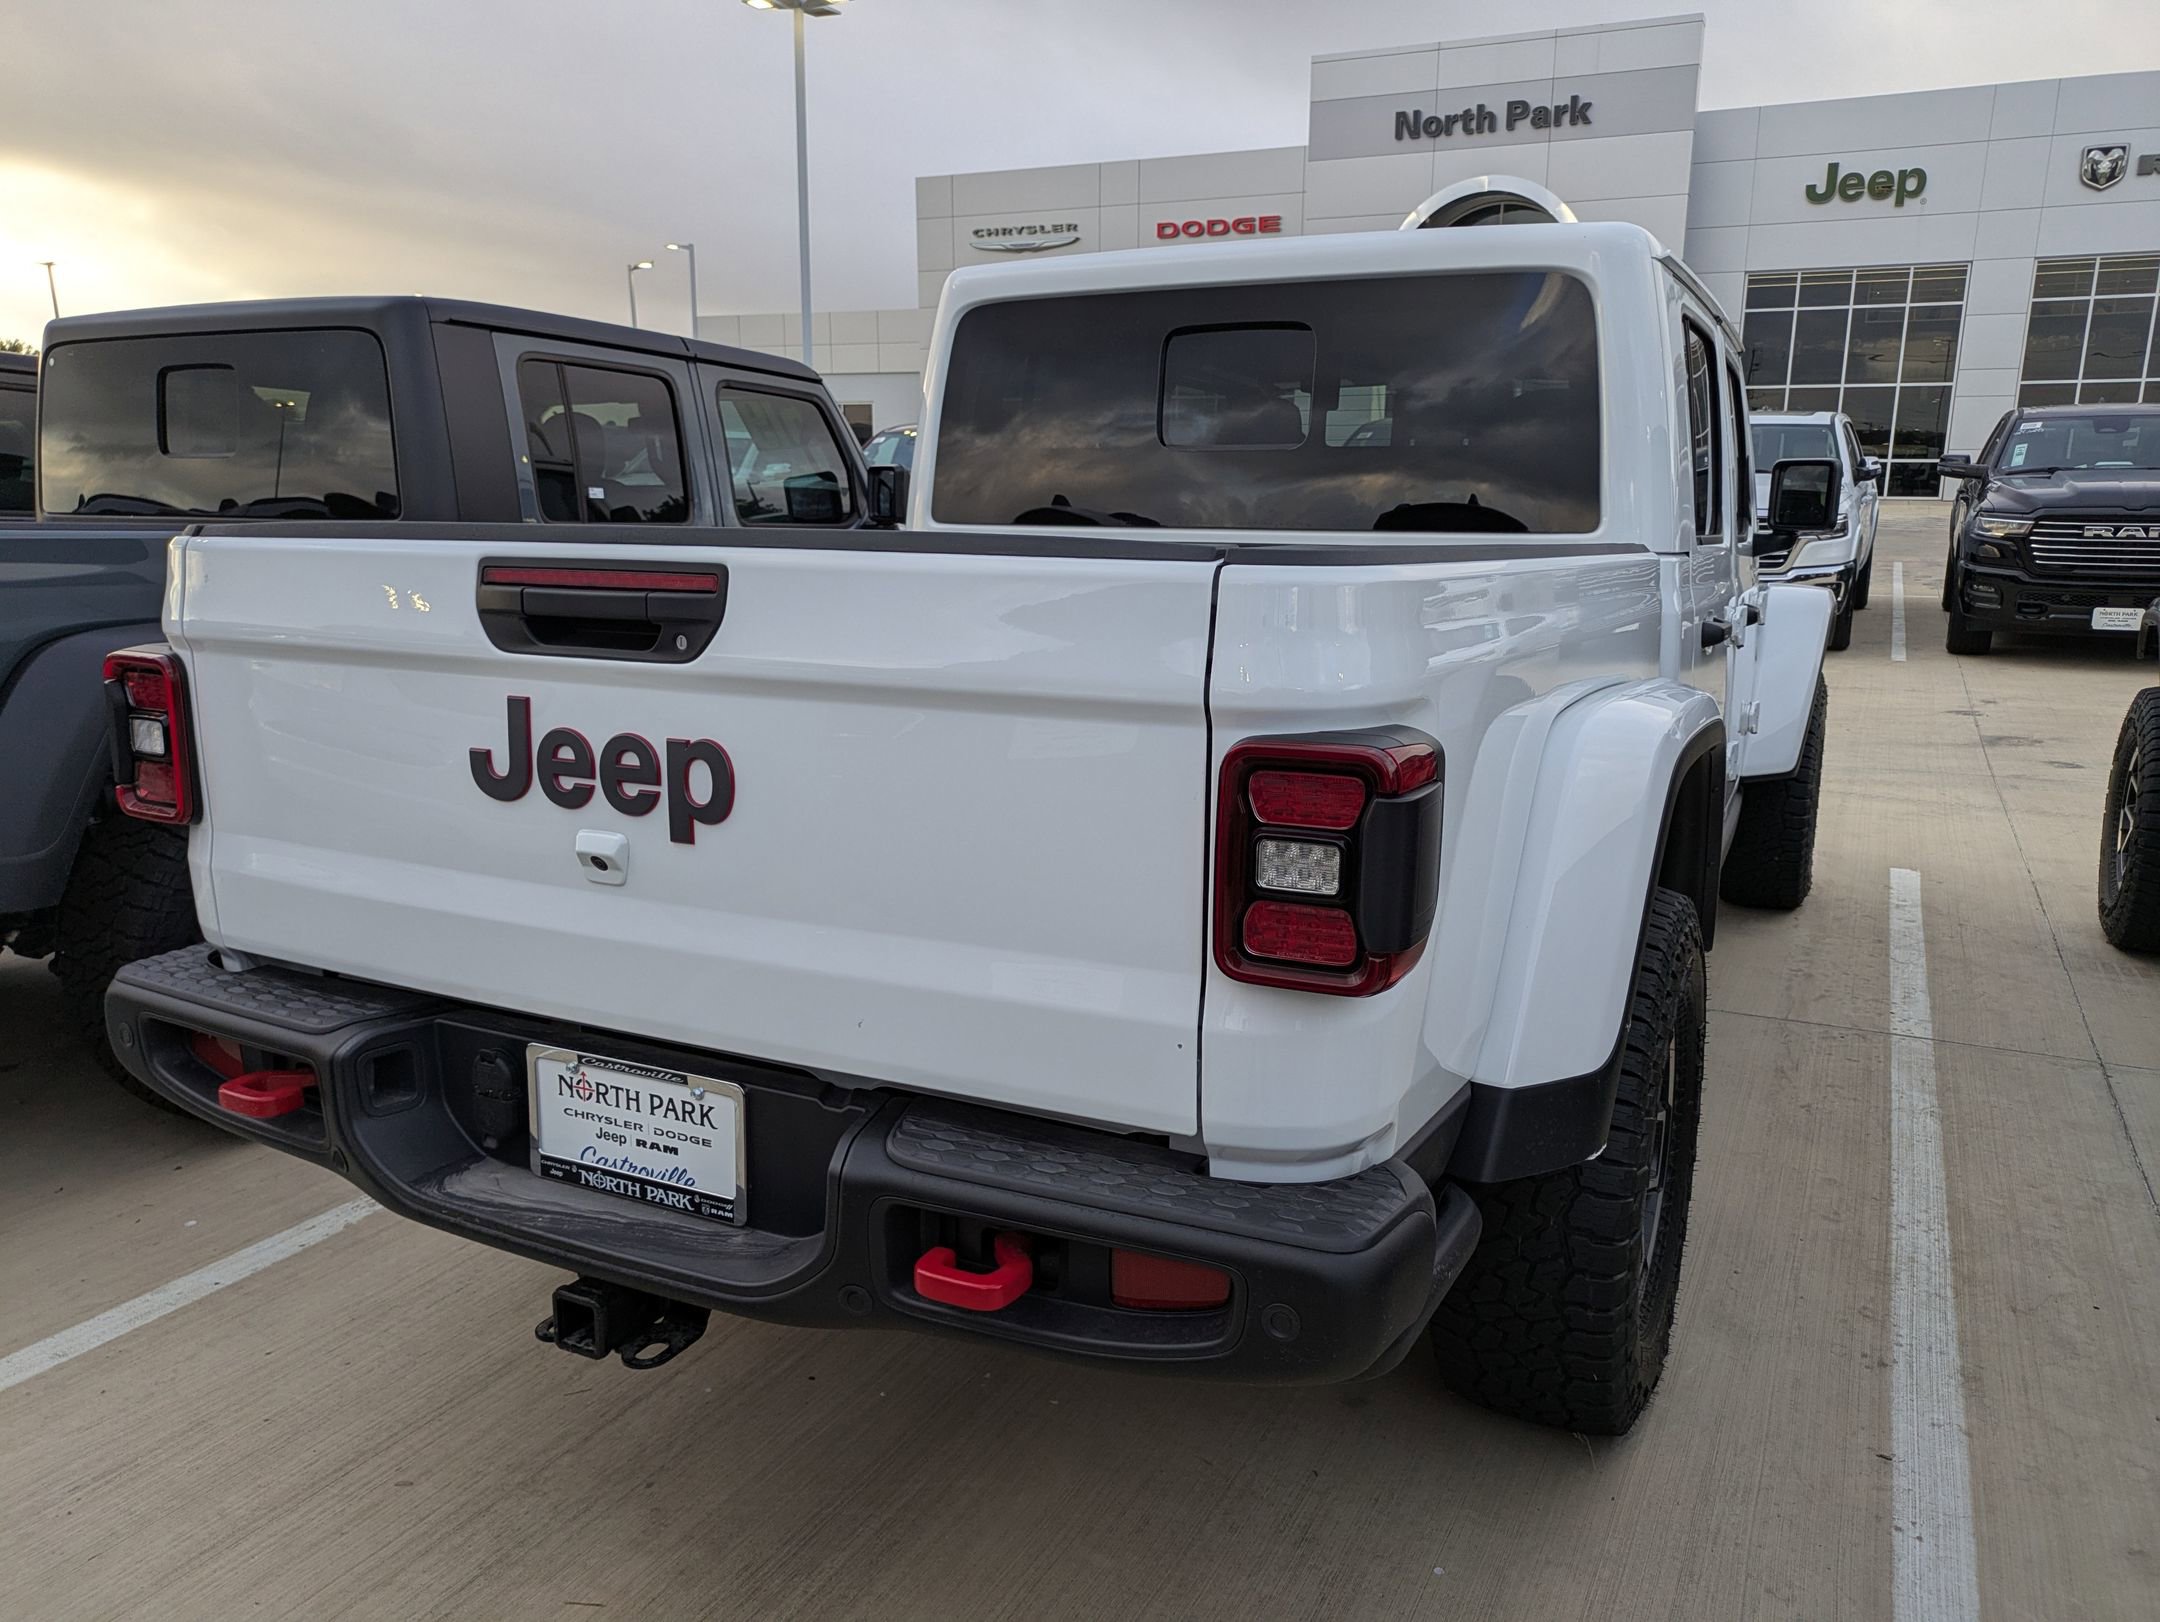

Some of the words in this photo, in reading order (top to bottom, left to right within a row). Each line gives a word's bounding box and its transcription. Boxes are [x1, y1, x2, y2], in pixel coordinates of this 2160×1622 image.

[1395, 104, 1496, 140] North
[1506, 95, 1592, 131] Park
[1805, 162, 1927, 207] Jeep
[973, 223, 1079, 238] CHRYSLER
[1156, 215, 1282, 240] DODGE
[469, 695, 735, 845] Jeep
[581, 1057, 684, 1083] Castroville
[558, 1073, 642, 1113] NORTH
[649, 1093, 719, 1130] PARK
[563, 1107, 644, 1133] CHRYSLER
[653, 1127, 713, 1148] DODGE
[595, 1127, 627, 1146] Jeep
[635, 1138, 679, 1156] RAM
[580, 1146, 696, 1187] Castroville
[578, 1169, 642, 1198] NORTH
[644, 1185, 695, 1211] PARK
[711, 1208, 733, 1218] RAM
